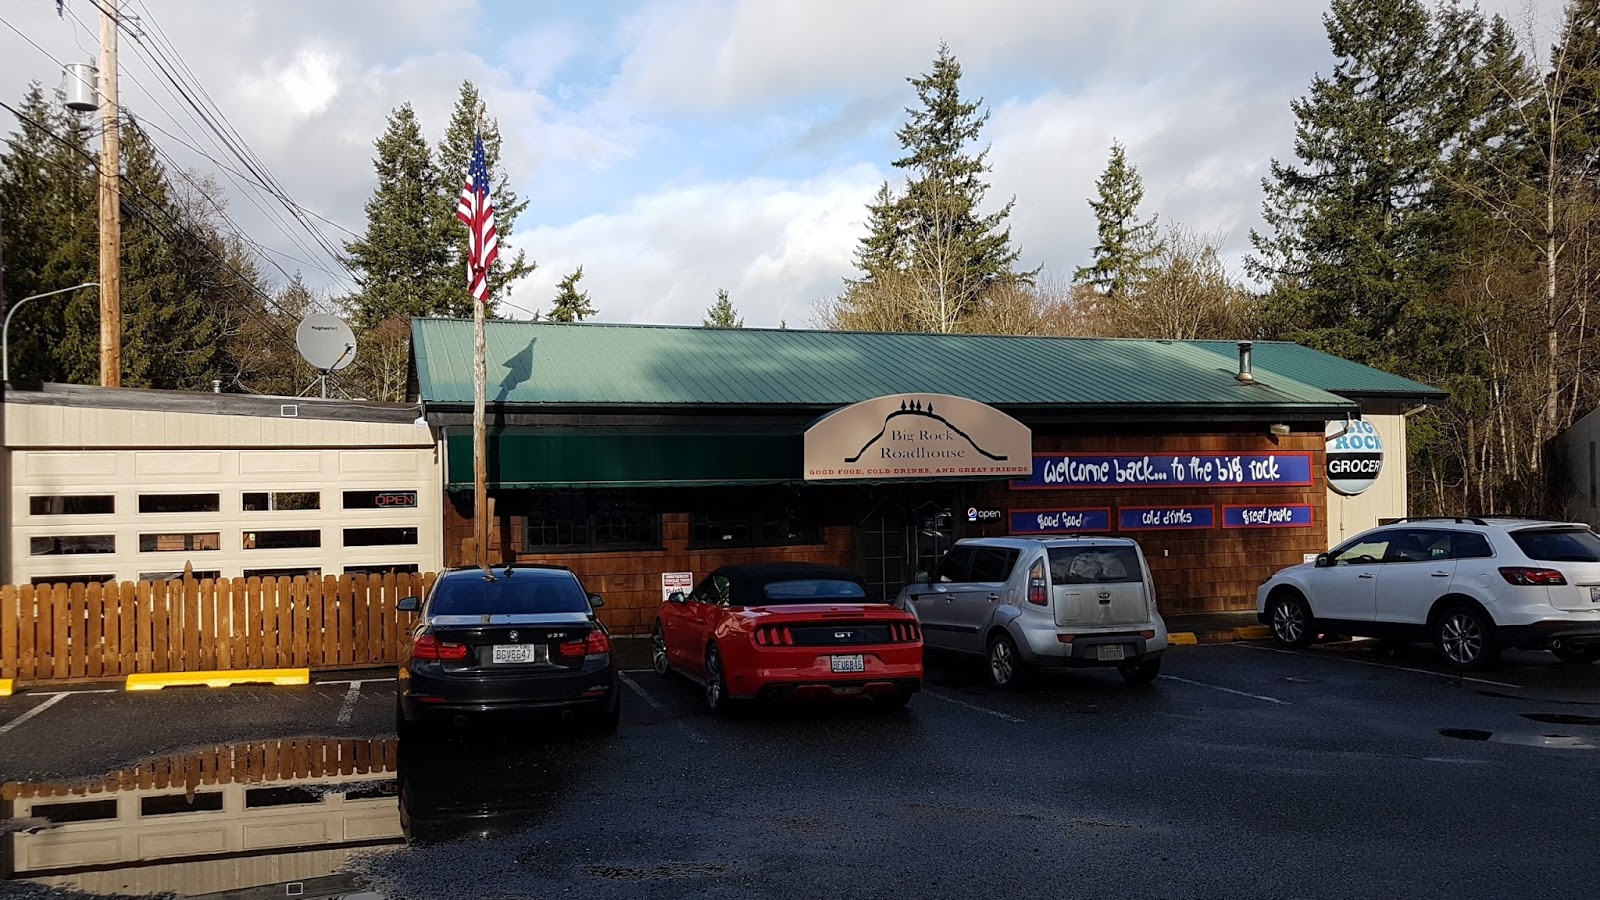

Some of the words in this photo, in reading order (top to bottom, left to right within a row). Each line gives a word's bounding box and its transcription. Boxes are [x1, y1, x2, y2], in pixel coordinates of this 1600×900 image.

[892, 430, 914, 442] Big
[920, 430, 953, 441] Rock
[880, 447, 965, 459] Roadhouse
[1044, 456, 1109, 484] welcome
[1113, 456, 1167, 483] back...
[1171, 456, 1185, 481] to
[1188, 456, 1212, 481] the
[1215, 455, 1243, 482] big
[1248, 455, 1280, 481] rock
[375, 495, 413, 505] OPEN
[978, 510, 1001, 520] open
[1037, 513, 1060, 530] good
[1062, 511, 1083, 528] food
[1142, 510, 1160, 525] cold
[1163, 509, 1192, 524] drinks
[1242, 509, 1267, 525] great
[1265, 507, 1292, 523] people
